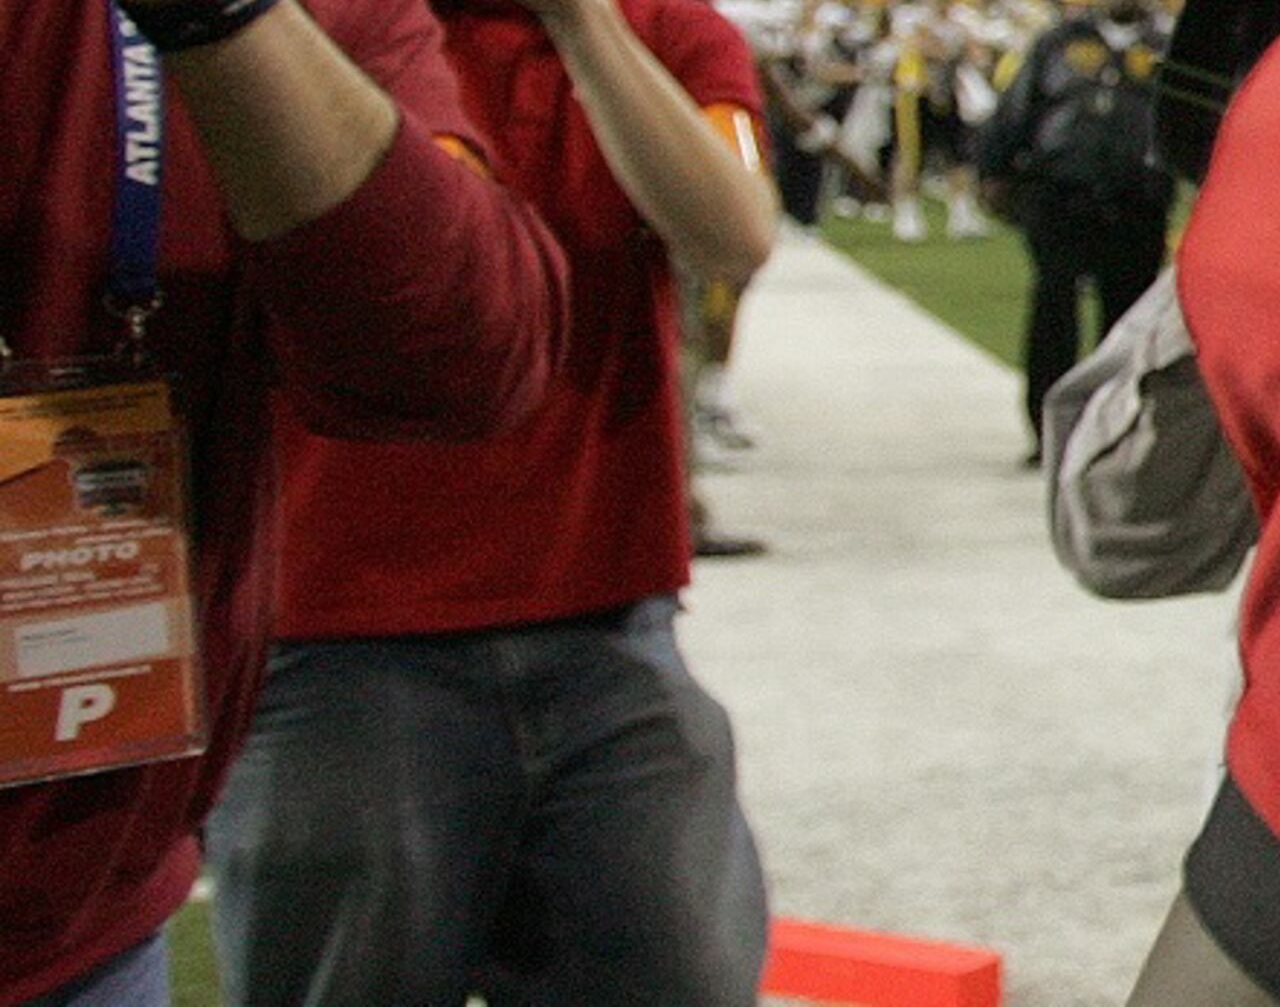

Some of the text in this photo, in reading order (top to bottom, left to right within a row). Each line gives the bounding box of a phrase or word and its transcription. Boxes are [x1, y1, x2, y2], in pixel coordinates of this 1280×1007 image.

[121, 42, 161, 185] ATLANTA
[20, 541, 140, 571] PHOTO
[55, 684, 117, 742] P
